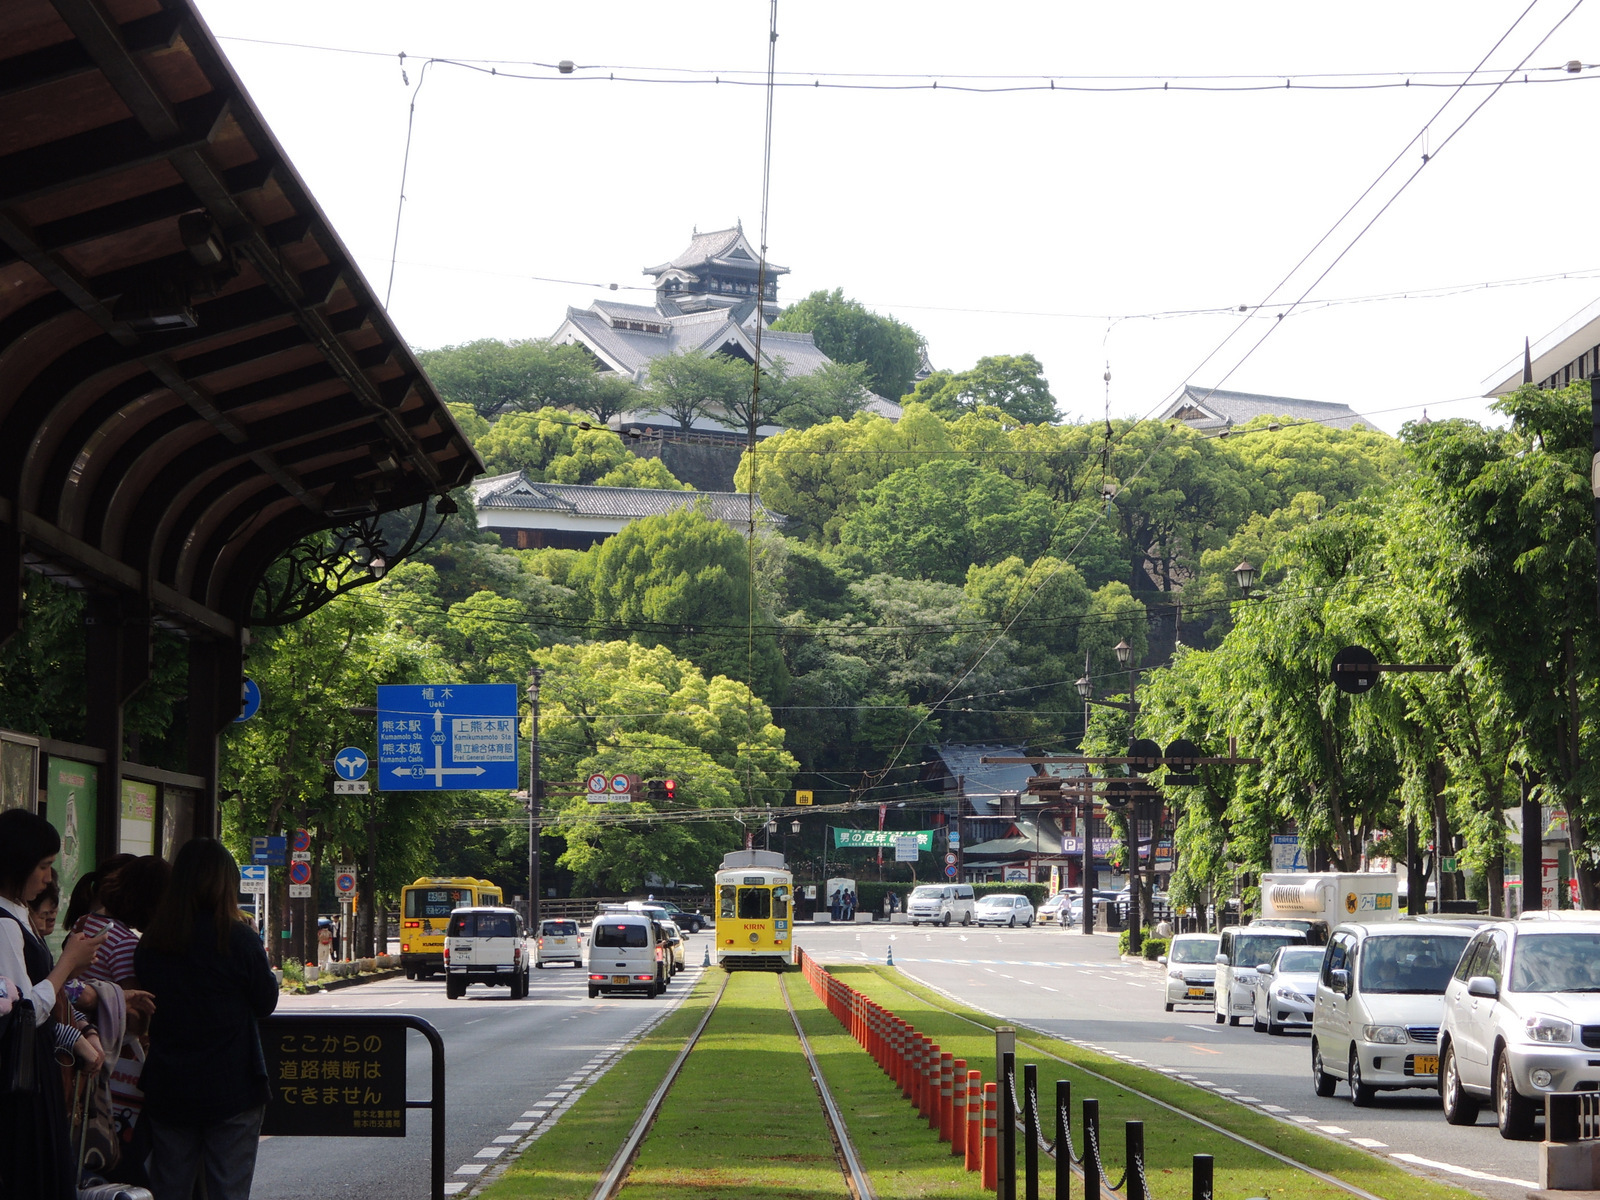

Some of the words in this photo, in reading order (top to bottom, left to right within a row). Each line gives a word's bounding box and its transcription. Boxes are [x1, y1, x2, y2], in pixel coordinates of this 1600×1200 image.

[422, 687, 453, 700] 植木
[382, 720, 422, 733] 熊本駅
[457, 721, 509, 732] 上熊本駅
[383, 743, 422, 755] 熊本城
[454, 744, 513, 754] 県立総合体育館
[408, 755, 423, 763] Castle
[412, 767, 423, 776] 28
[252, 837, 268, 855] P
[1067, 840, 1074, 850] P
[280, 1035, 382, 1053] ここからの
[279, 1060, 382, 1080] 道路横断は
[279, 1086, 382, 1105] できません
